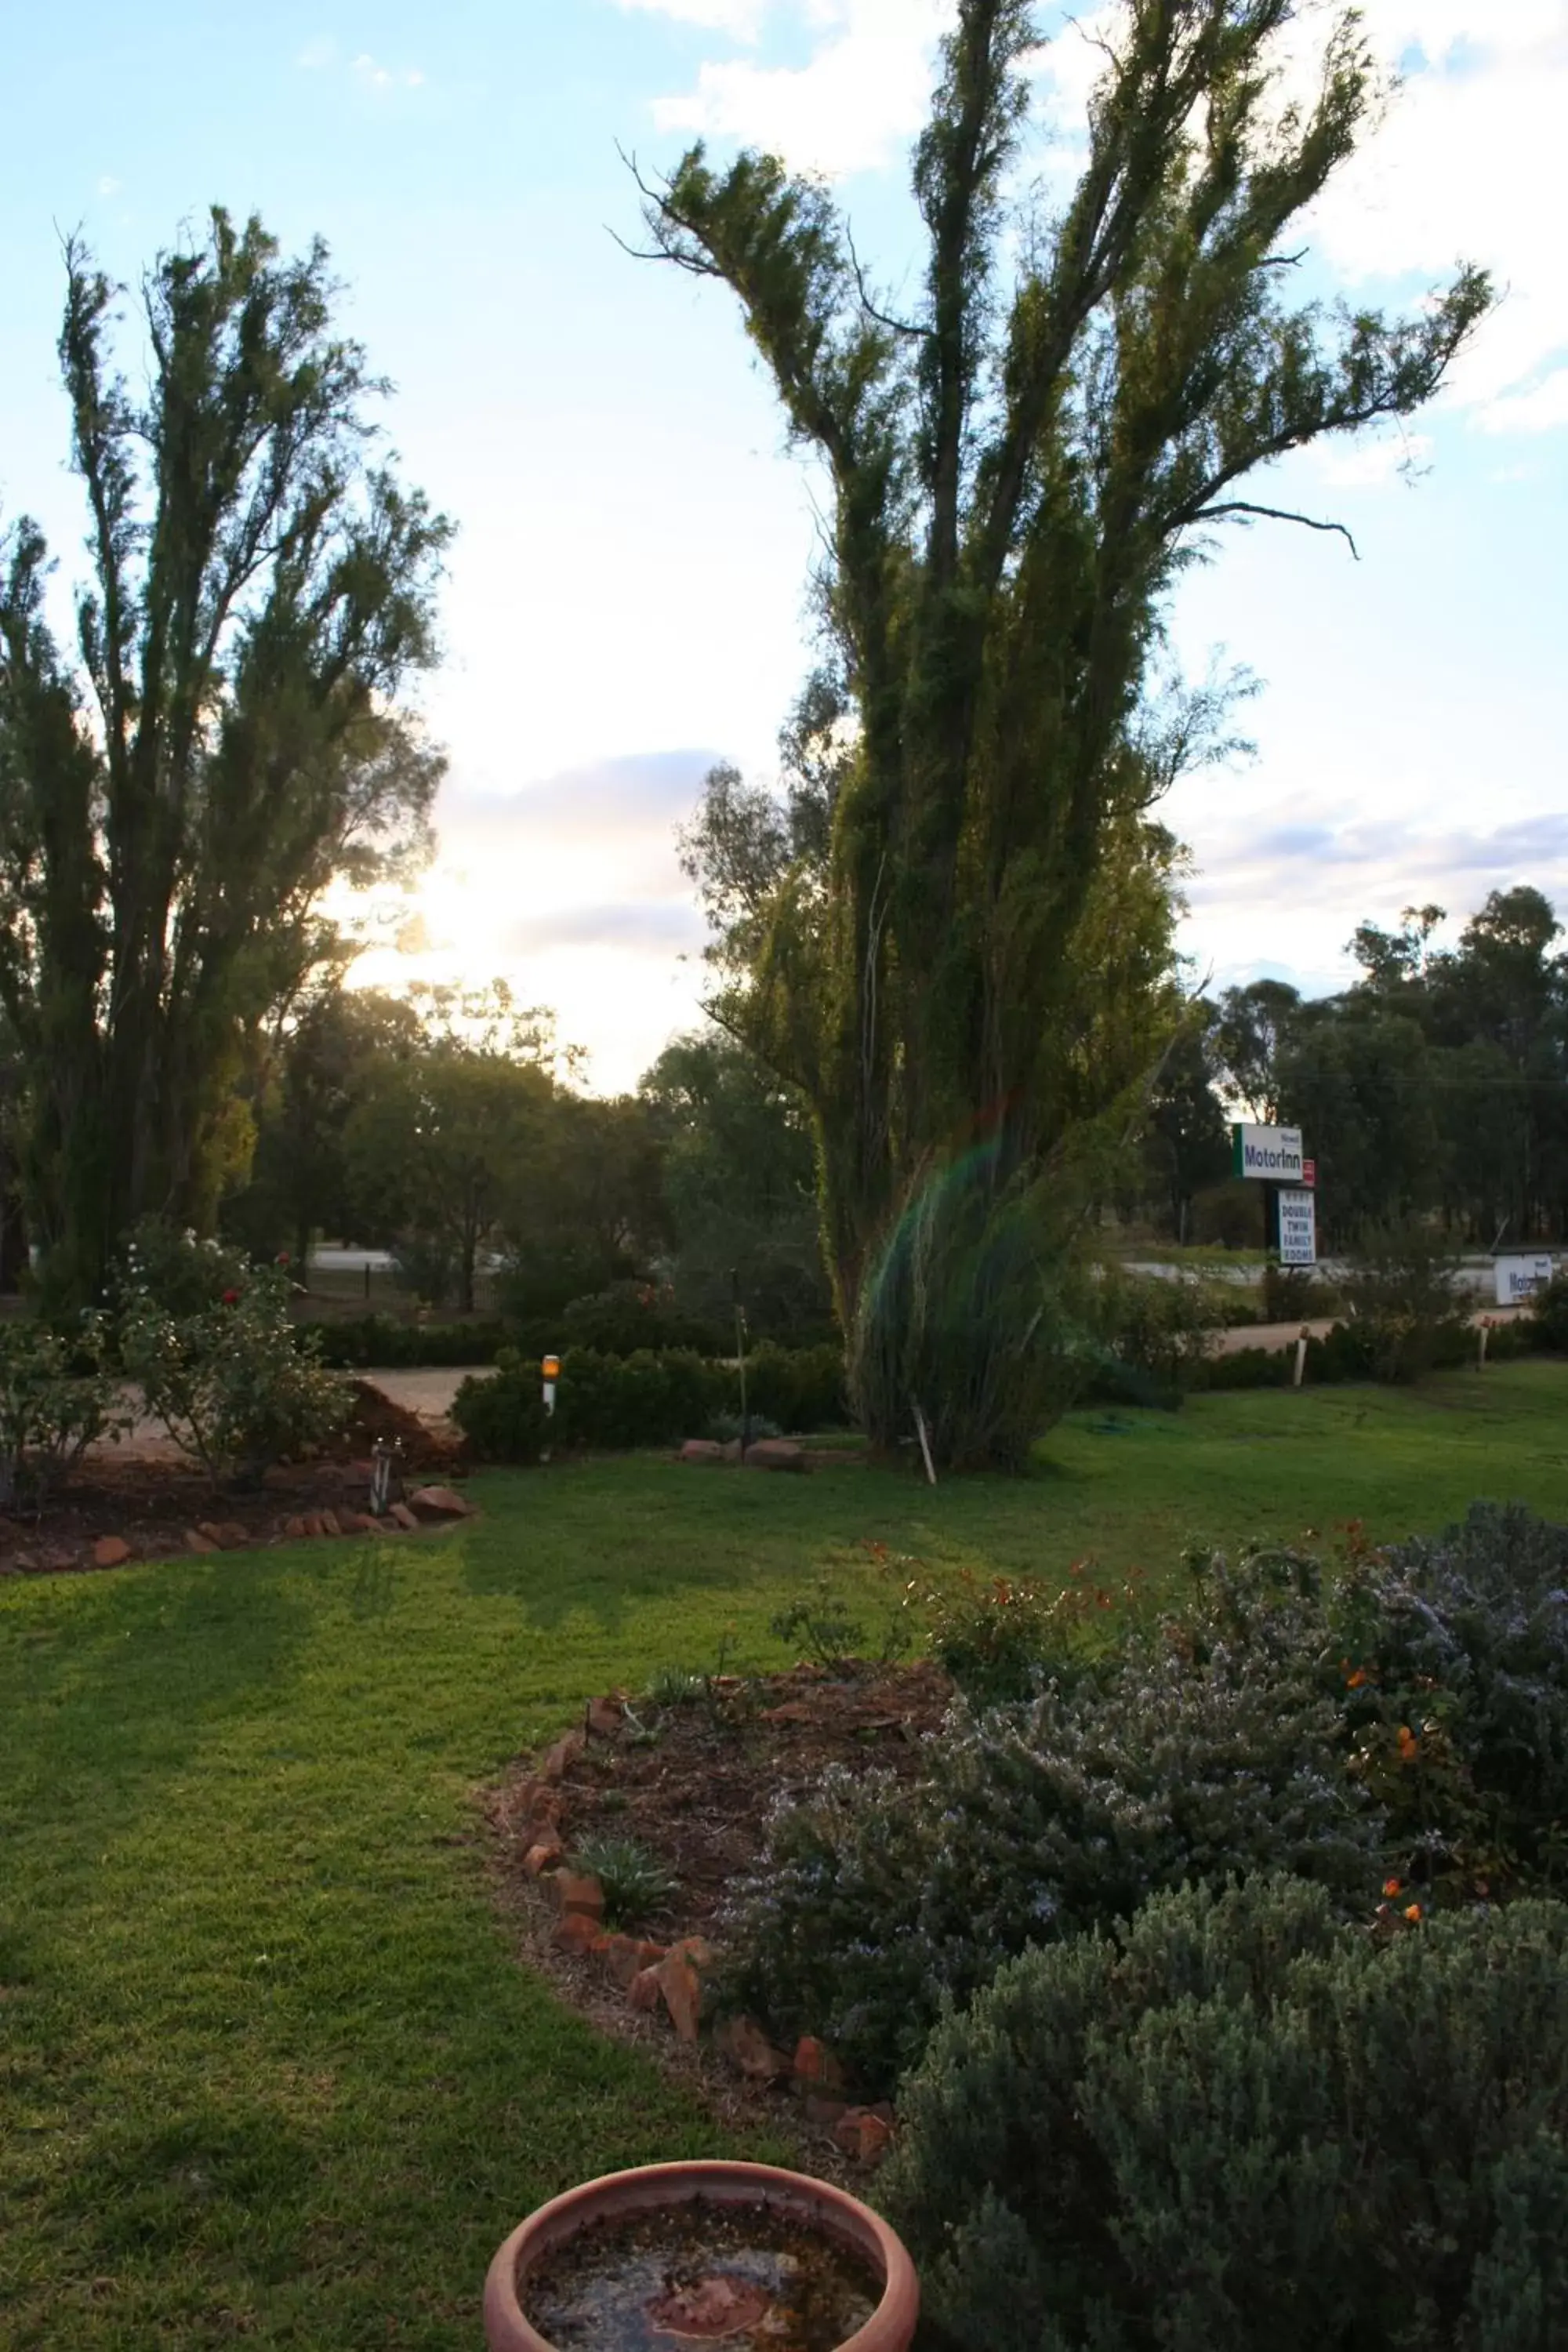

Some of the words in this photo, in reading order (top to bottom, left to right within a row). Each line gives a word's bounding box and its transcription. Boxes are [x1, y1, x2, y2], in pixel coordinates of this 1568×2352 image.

[1244, 1145, 1301, 1170] MotorInn
[1282, 1205, 1312, 1218] DOUBLE
[1287, 1220, 1308, 1233] TWIN
[1283, 1234, 1312, 1247] FAMILY
